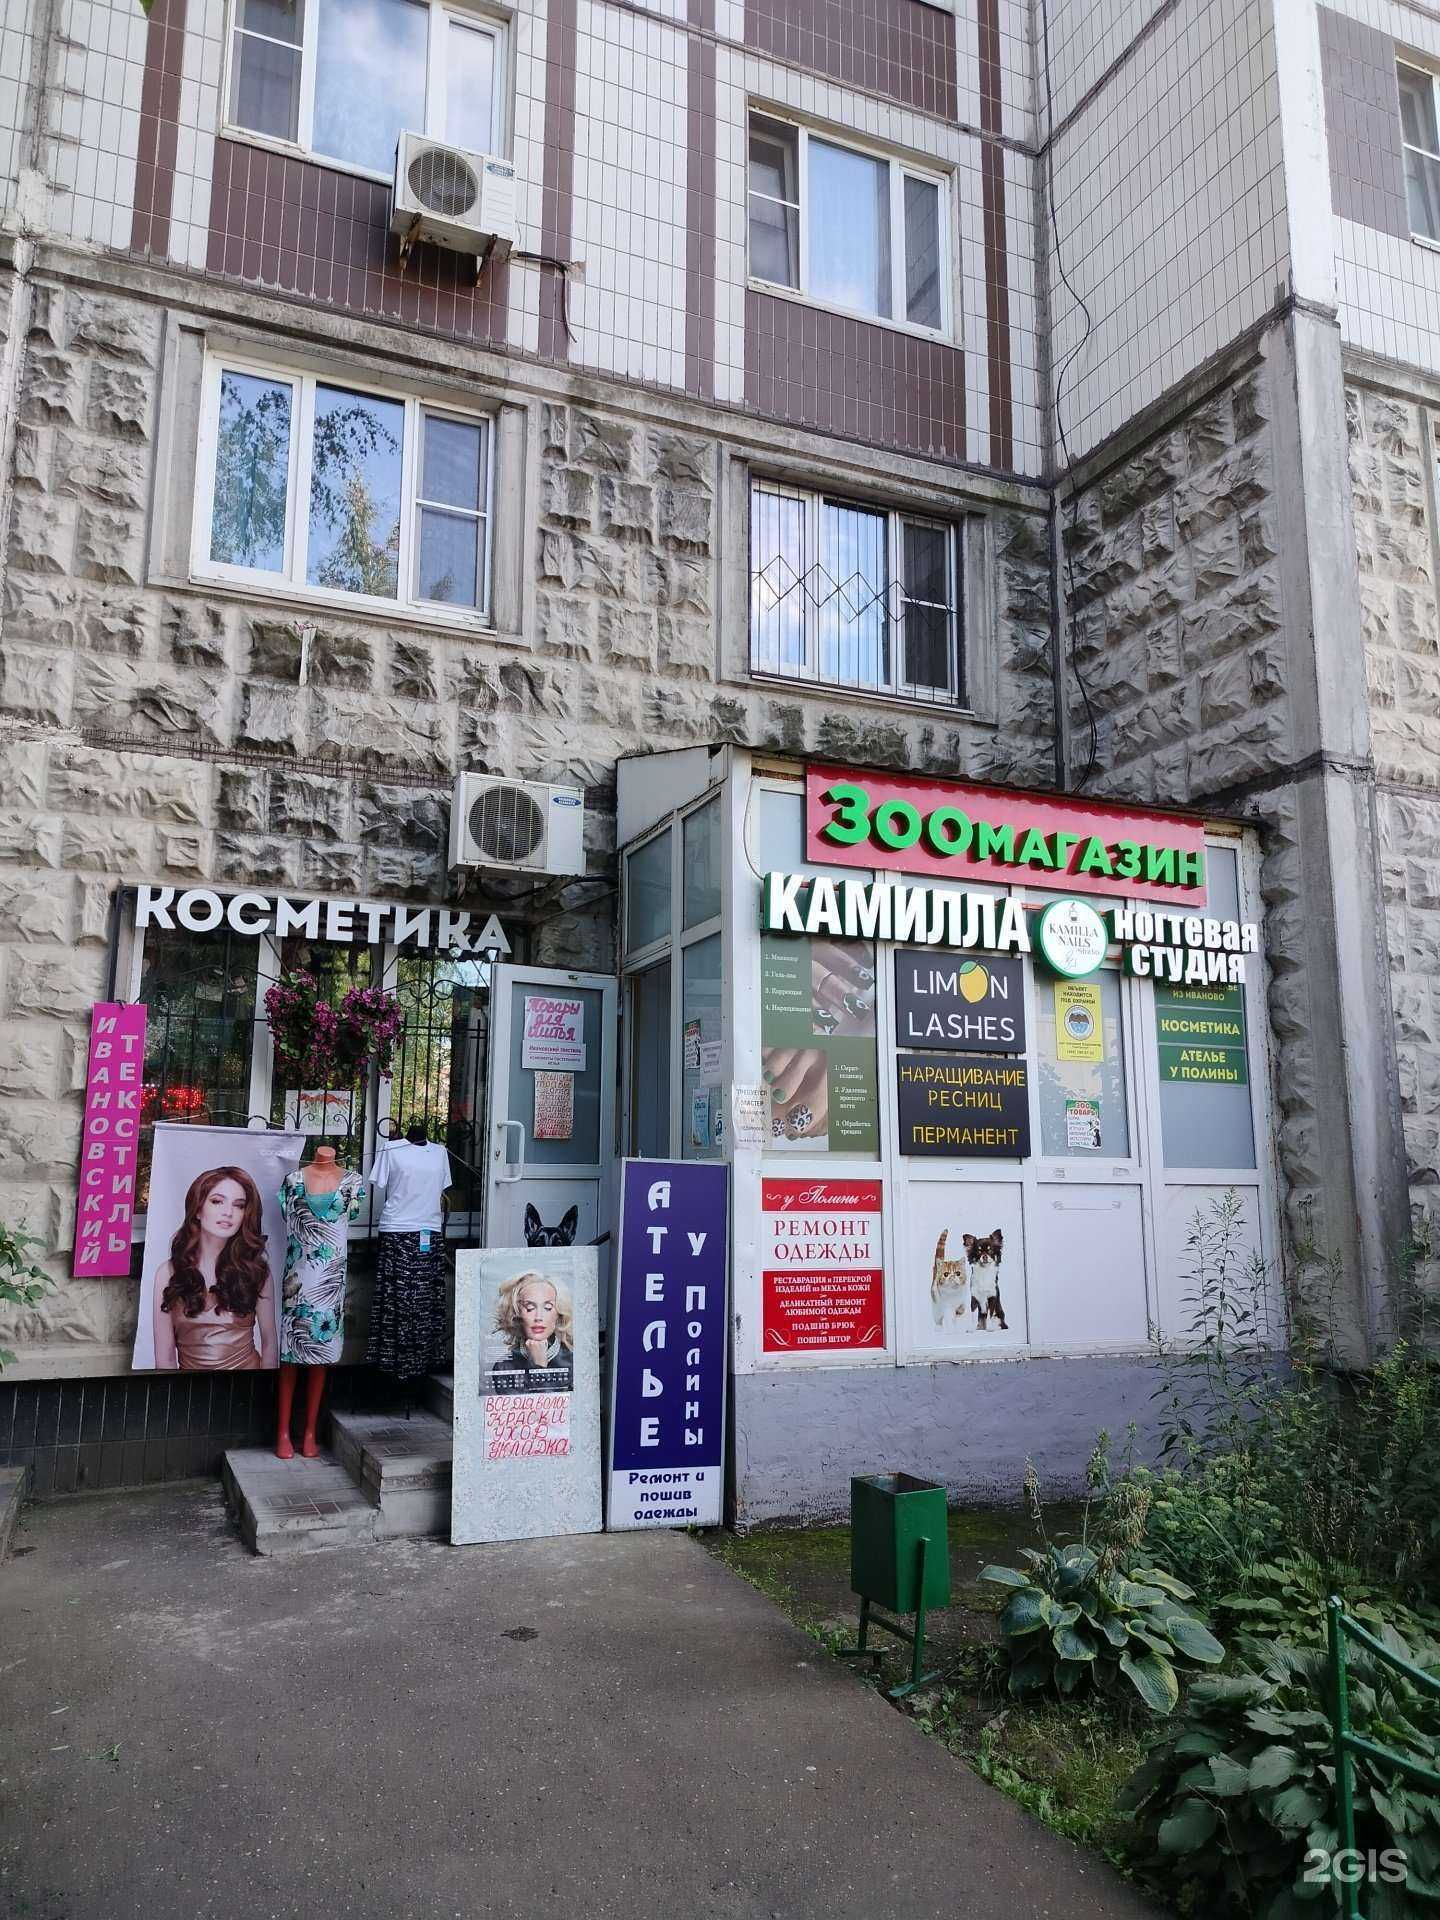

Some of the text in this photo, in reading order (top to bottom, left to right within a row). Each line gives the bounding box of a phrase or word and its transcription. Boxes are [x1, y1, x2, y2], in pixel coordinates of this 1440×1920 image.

[822, 783, 1205, 888] ЗООМАГАЗИН
[135, 884, 513, 954] КОСМЕТИКА
[767, 871, 1032, 953] КАМИЛЛА
[1048, 923, 1099, 938] KAMILLA
[1057, 935, 1091, 948] NAILS
[1172, 989, 1225, 1001] ИЗ ИВАНОВО
[908, 1011, 1016, 1042] LASHES
[1160, 1018, 1241, 1036] КОСМЕТИКА
[1180, 1049, 1227, 1064] АТЕЛЬЕ
[901, 1065, 1026, 1087] НАРАЩИВАНИЕ
[1169, 1065, 1238, 1081] У ПОЛИНЫ
[928, 1089, 1002, 1111] РЕСНИЦ
[79, 1015, 117, 1265] ИВАНОВСКИЙ
[108, 1034, 139, 1253] ТЕКСТИЛЬ
[912, 1126, 1019, 1146] ПЕРМАНЕНТ
[798, 1185, 861, 1205] Полины
[774, 1220, 870, 1237] РЕМОНТ
[774, 1243, 871, 1263] ОДЕЖДЫ
[773, 1276, 826, 1285] РЕСТАВРАЦИЯ
[832, 1274, 872, 1283] ПЕРЕКРОЙ
[775, 1284, 812, 1294] ИЗДЕЛИЙ
[848, 1284, 870, 1292] КОЖИ
[780, 1298, 866, 1308] ДЕЛИКАТНЫЙ РЕМОНТ
[785, 1306, 862, 1316] ЛЮБИМОЙ ОДЕЖДЫ
[639, 1180, 672, 1448] АТЕЛЬЕ
[792, 1321, 856, 1331] ПОДШИВ БРЮК
[797, 1335, 850, 1344] ПОШИВ ШТОР
[487, 1410, 566, 1427] КРАСКИ
[492, 1423, 549, 1442] УХОД
[628, 1471, 705, 1485] Ремонт и
[640, 1489, 693, 1503] пошив
[633, 1505, 698, 1522] одежды
